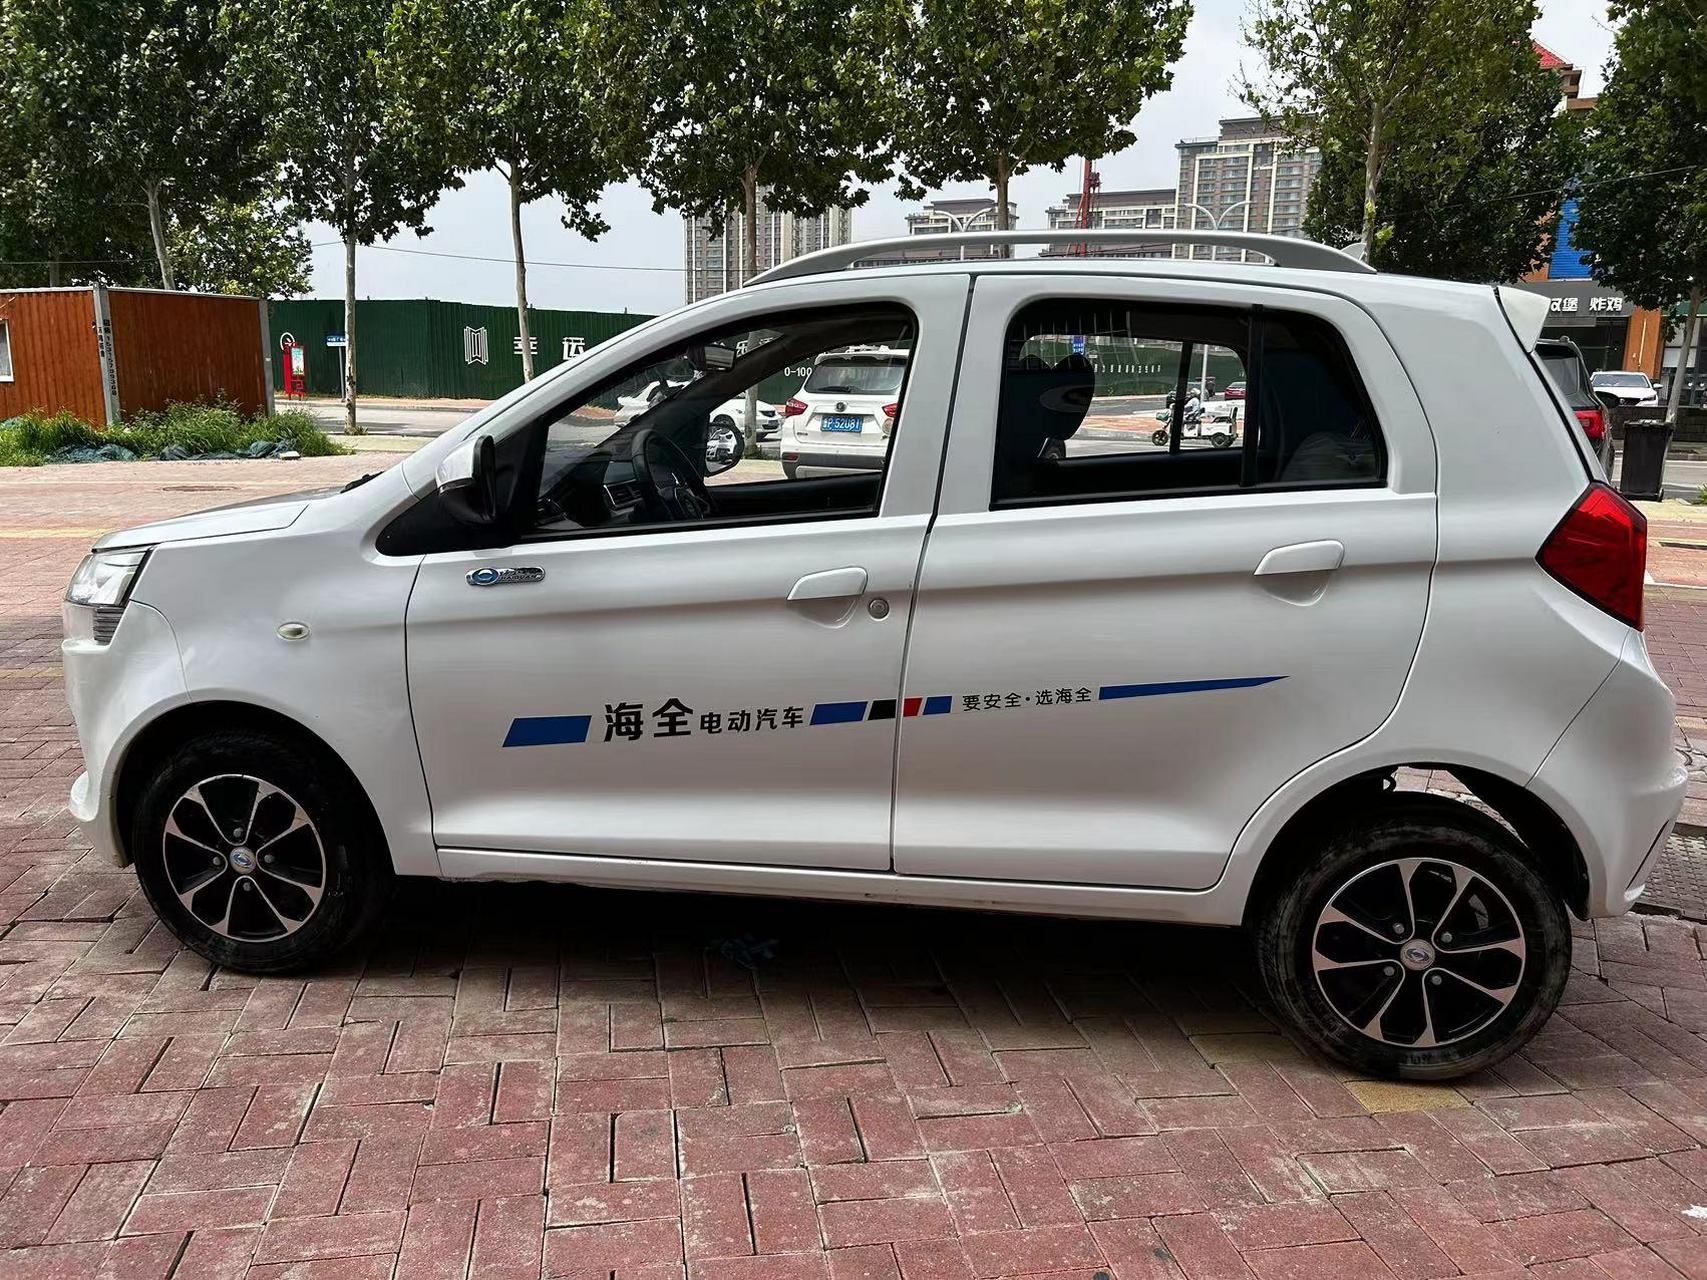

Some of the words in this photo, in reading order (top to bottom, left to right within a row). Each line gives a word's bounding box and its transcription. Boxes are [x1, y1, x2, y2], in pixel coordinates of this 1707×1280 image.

[1589, 297, 1623, 312] 炸鸡
[603, 697, 804, 742] 海全电动汽车
